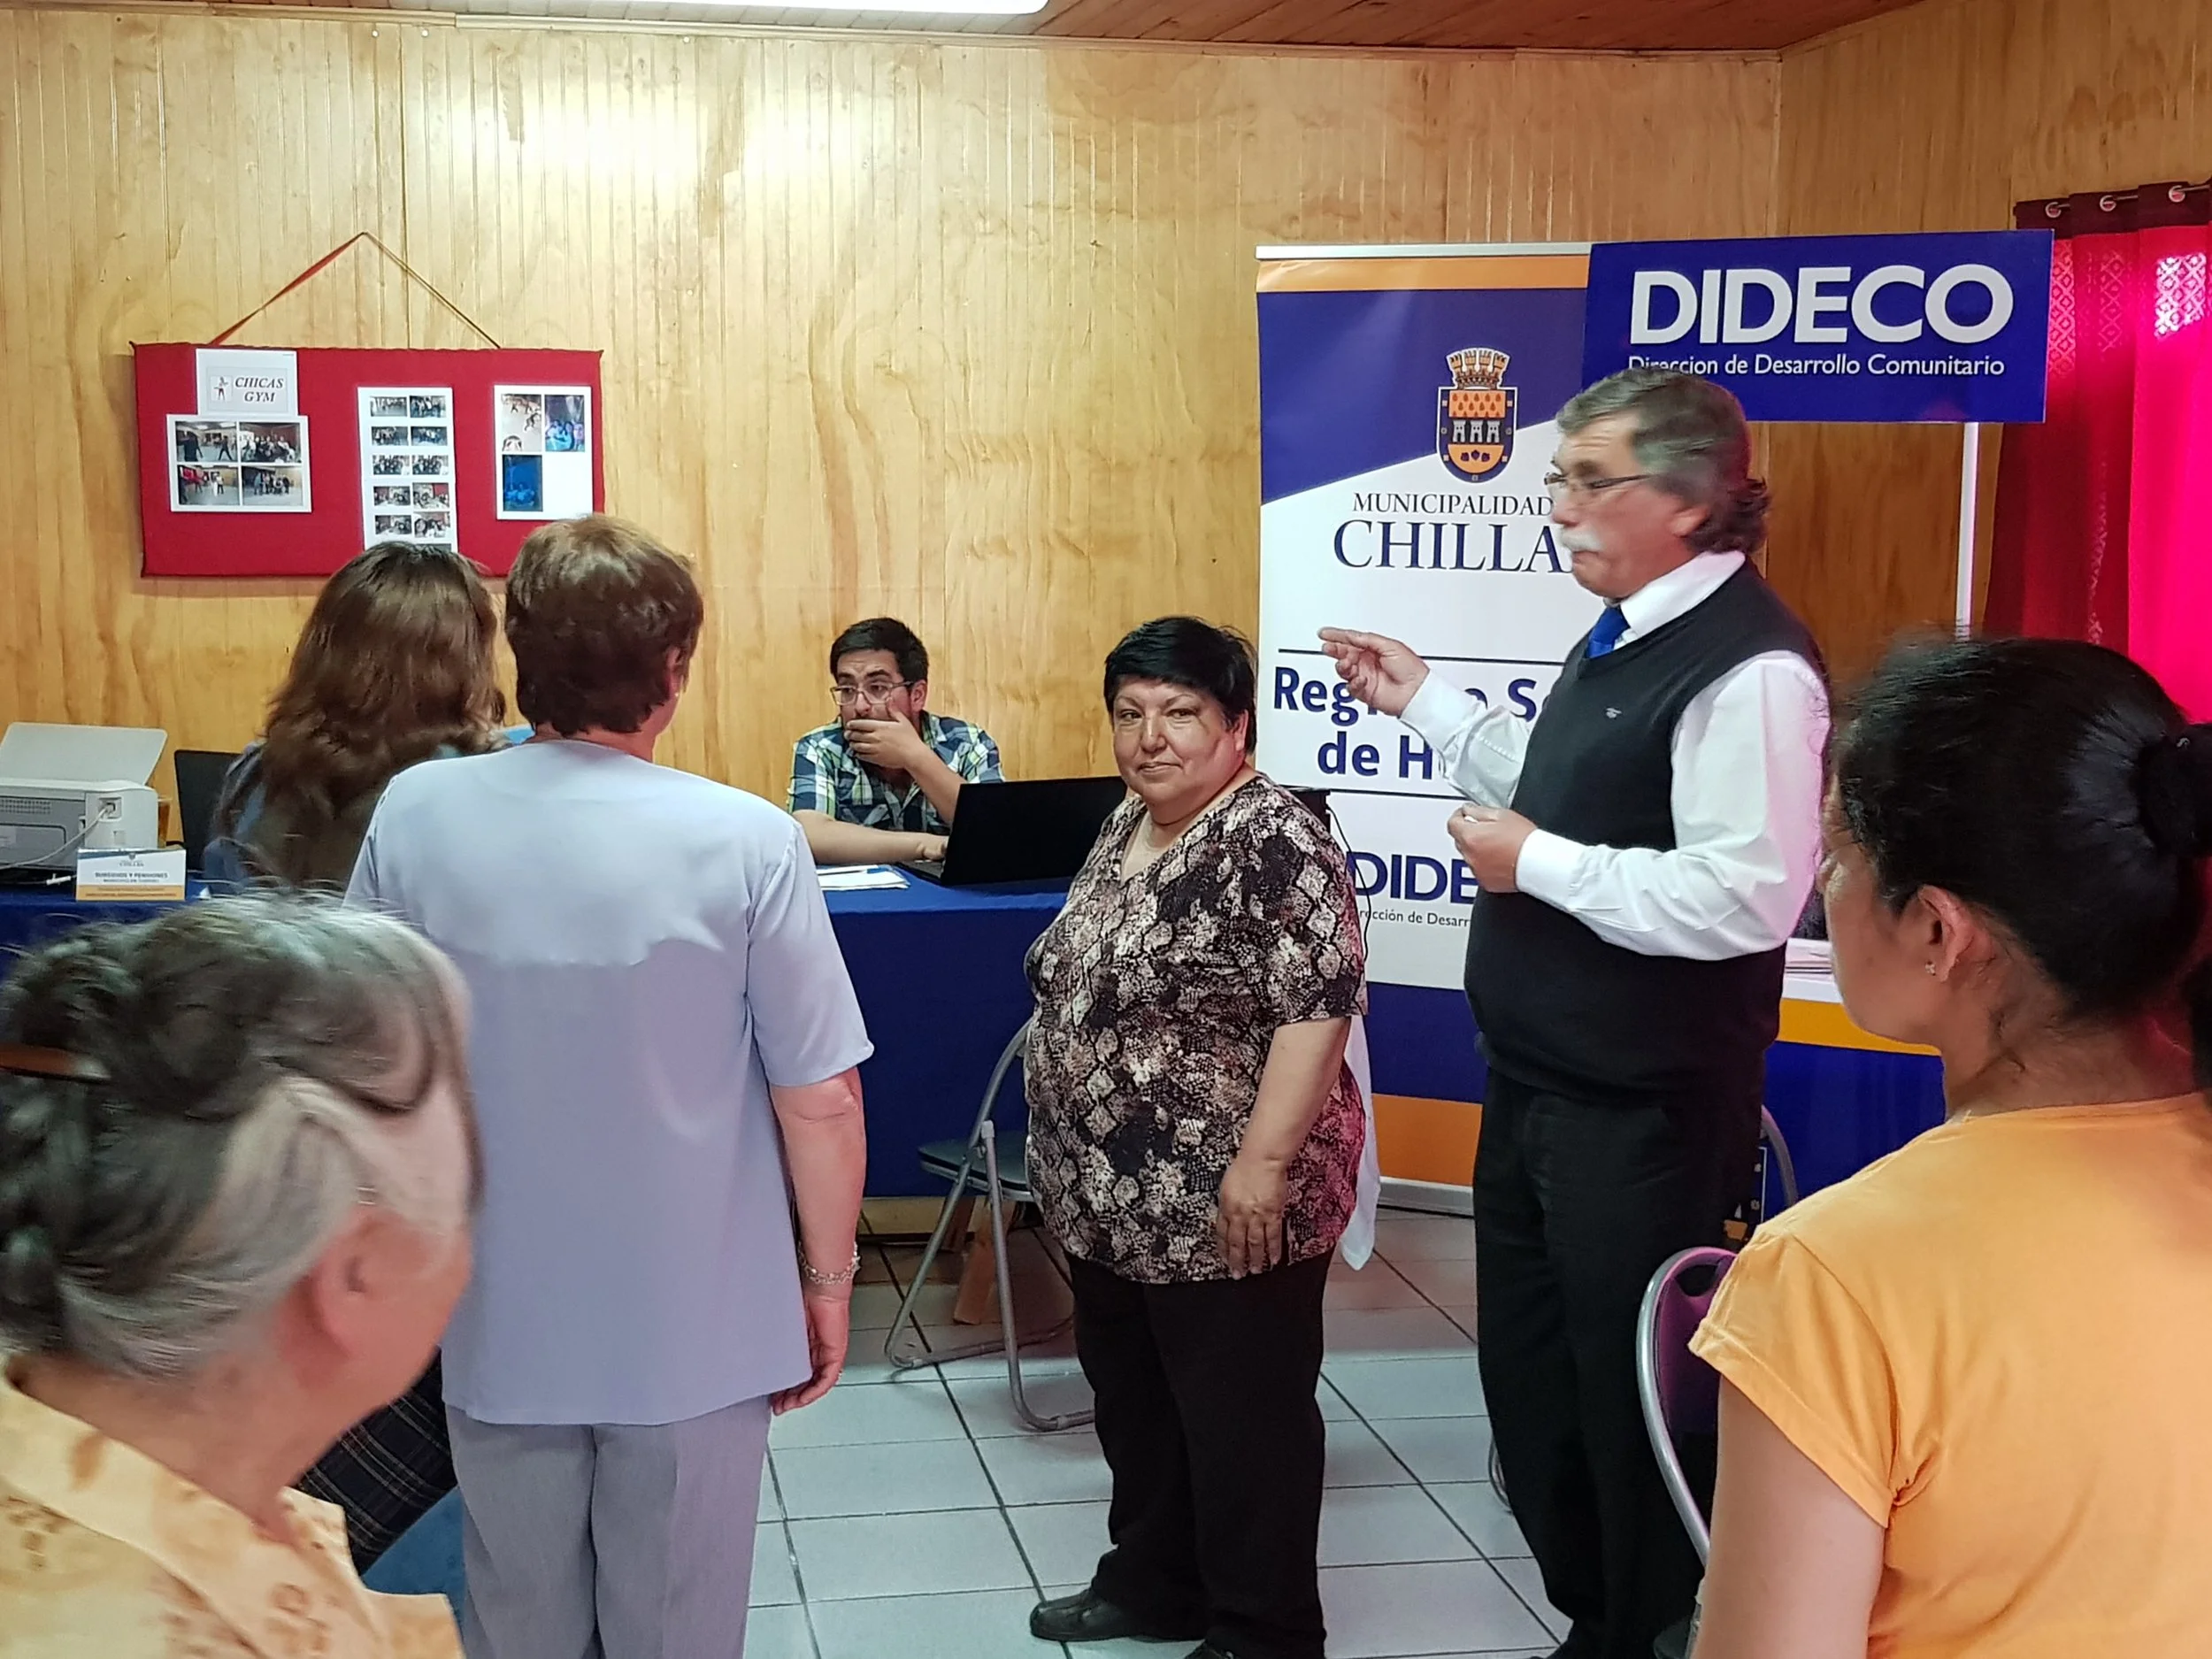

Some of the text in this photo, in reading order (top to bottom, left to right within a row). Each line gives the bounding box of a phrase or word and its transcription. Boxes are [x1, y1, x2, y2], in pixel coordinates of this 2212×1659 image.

[1630, 264, 2014, 344] DIDECO
[1725, 354, 1748, 374] de
[1755, 354, 1861, 375] Desarrollo
[1868, 354, 2005, 376] Comunitario
[234, 376, 285, 388] CHICAS
[244, 391, 276, 403] GYM
[1353, 492, 1555, 517] MUNICIPALIDAD
[1333, 518, 1572, 574] CHILLA
[1317, 731, 1380, 776] de
[1346, 851, 1479, 904] DIDE
[1408, 910, 1423, 924] de
[1427, 912, 1470, 927] Desarr
